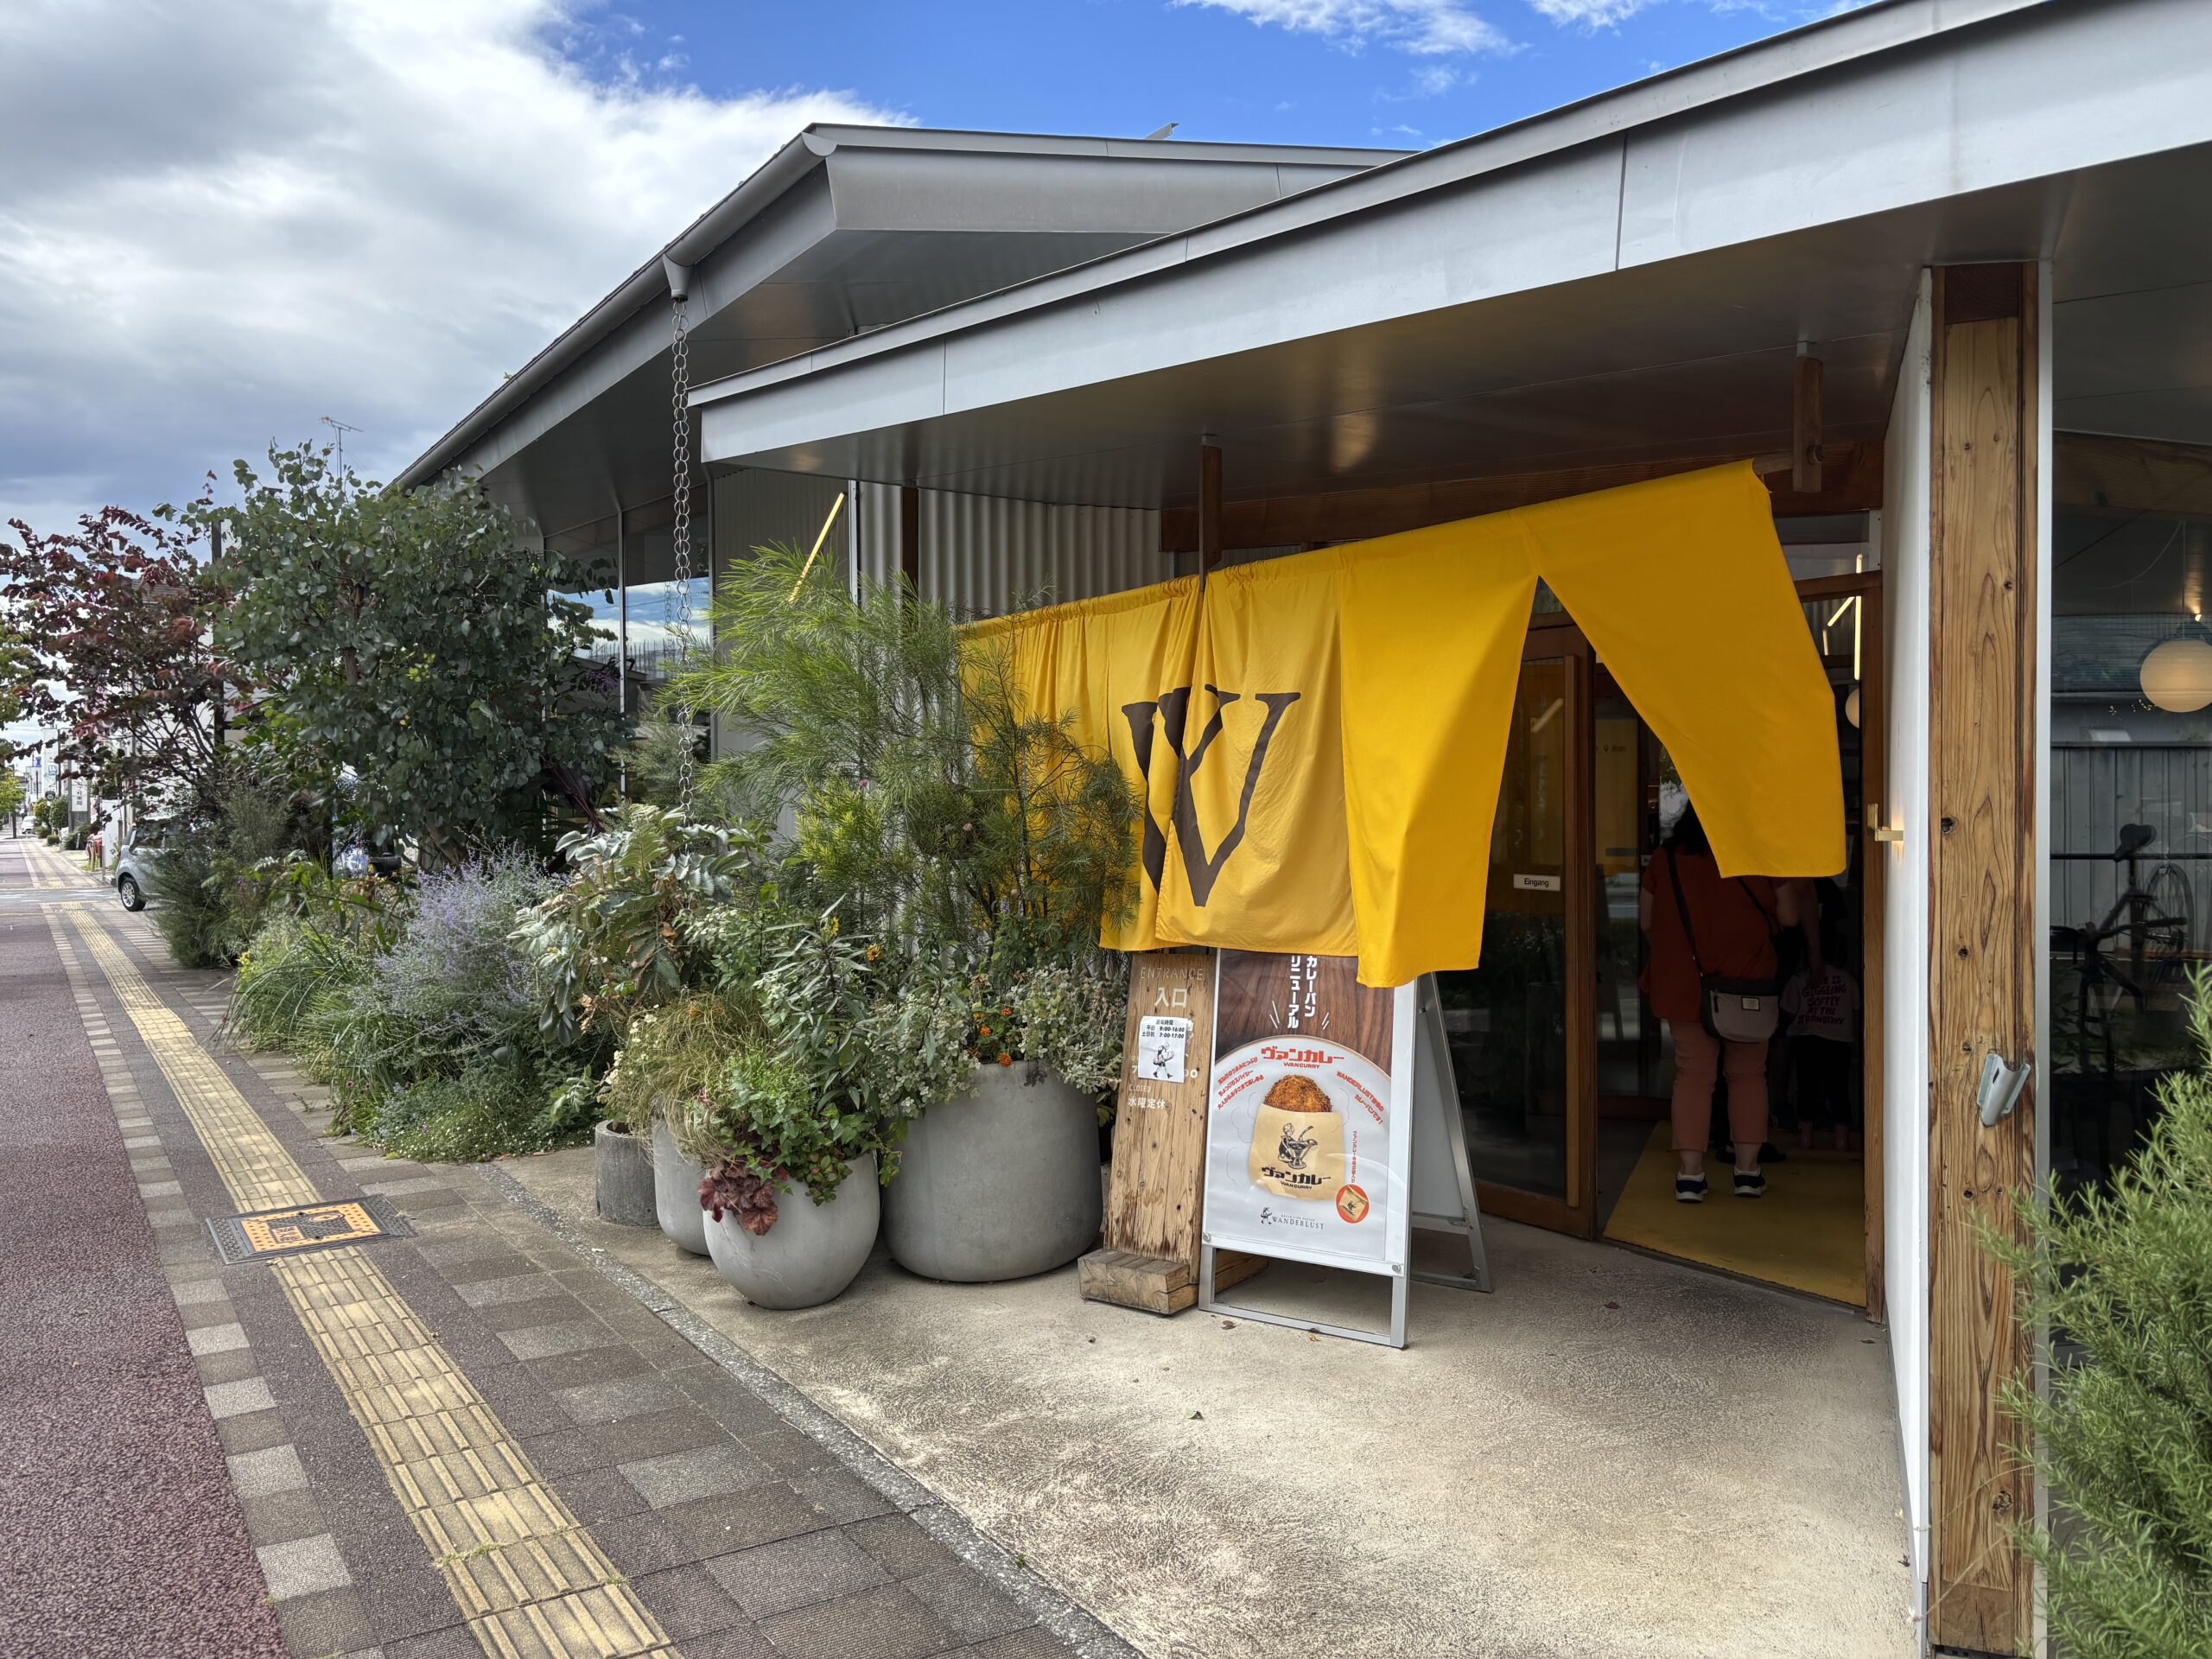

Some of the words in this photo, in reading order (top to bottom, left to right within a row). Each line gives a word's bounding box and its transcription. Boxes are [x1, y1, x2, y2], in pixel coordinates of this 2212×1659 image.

[1523, 877, 1549, 887] Eingang
[1141, 967, 1204, 981] ENTRANCE
[1287, 955, 1301, 1029] リニューアル
[1304, 955, 1318, 1017] カレーパン
[1154, 987, 1187, 1008] 入口
[1261, 1046, 1344, 1064] ヴァンカレー
[1128, 1084, 1151, 1093] CLOSED
[1128, 1096, 1166, 1109] 水曜定休
[1261, 1166, 1332, 1185] ヴァンカレー
[1272, 1216, 1325, 1230] WANDERLUST
